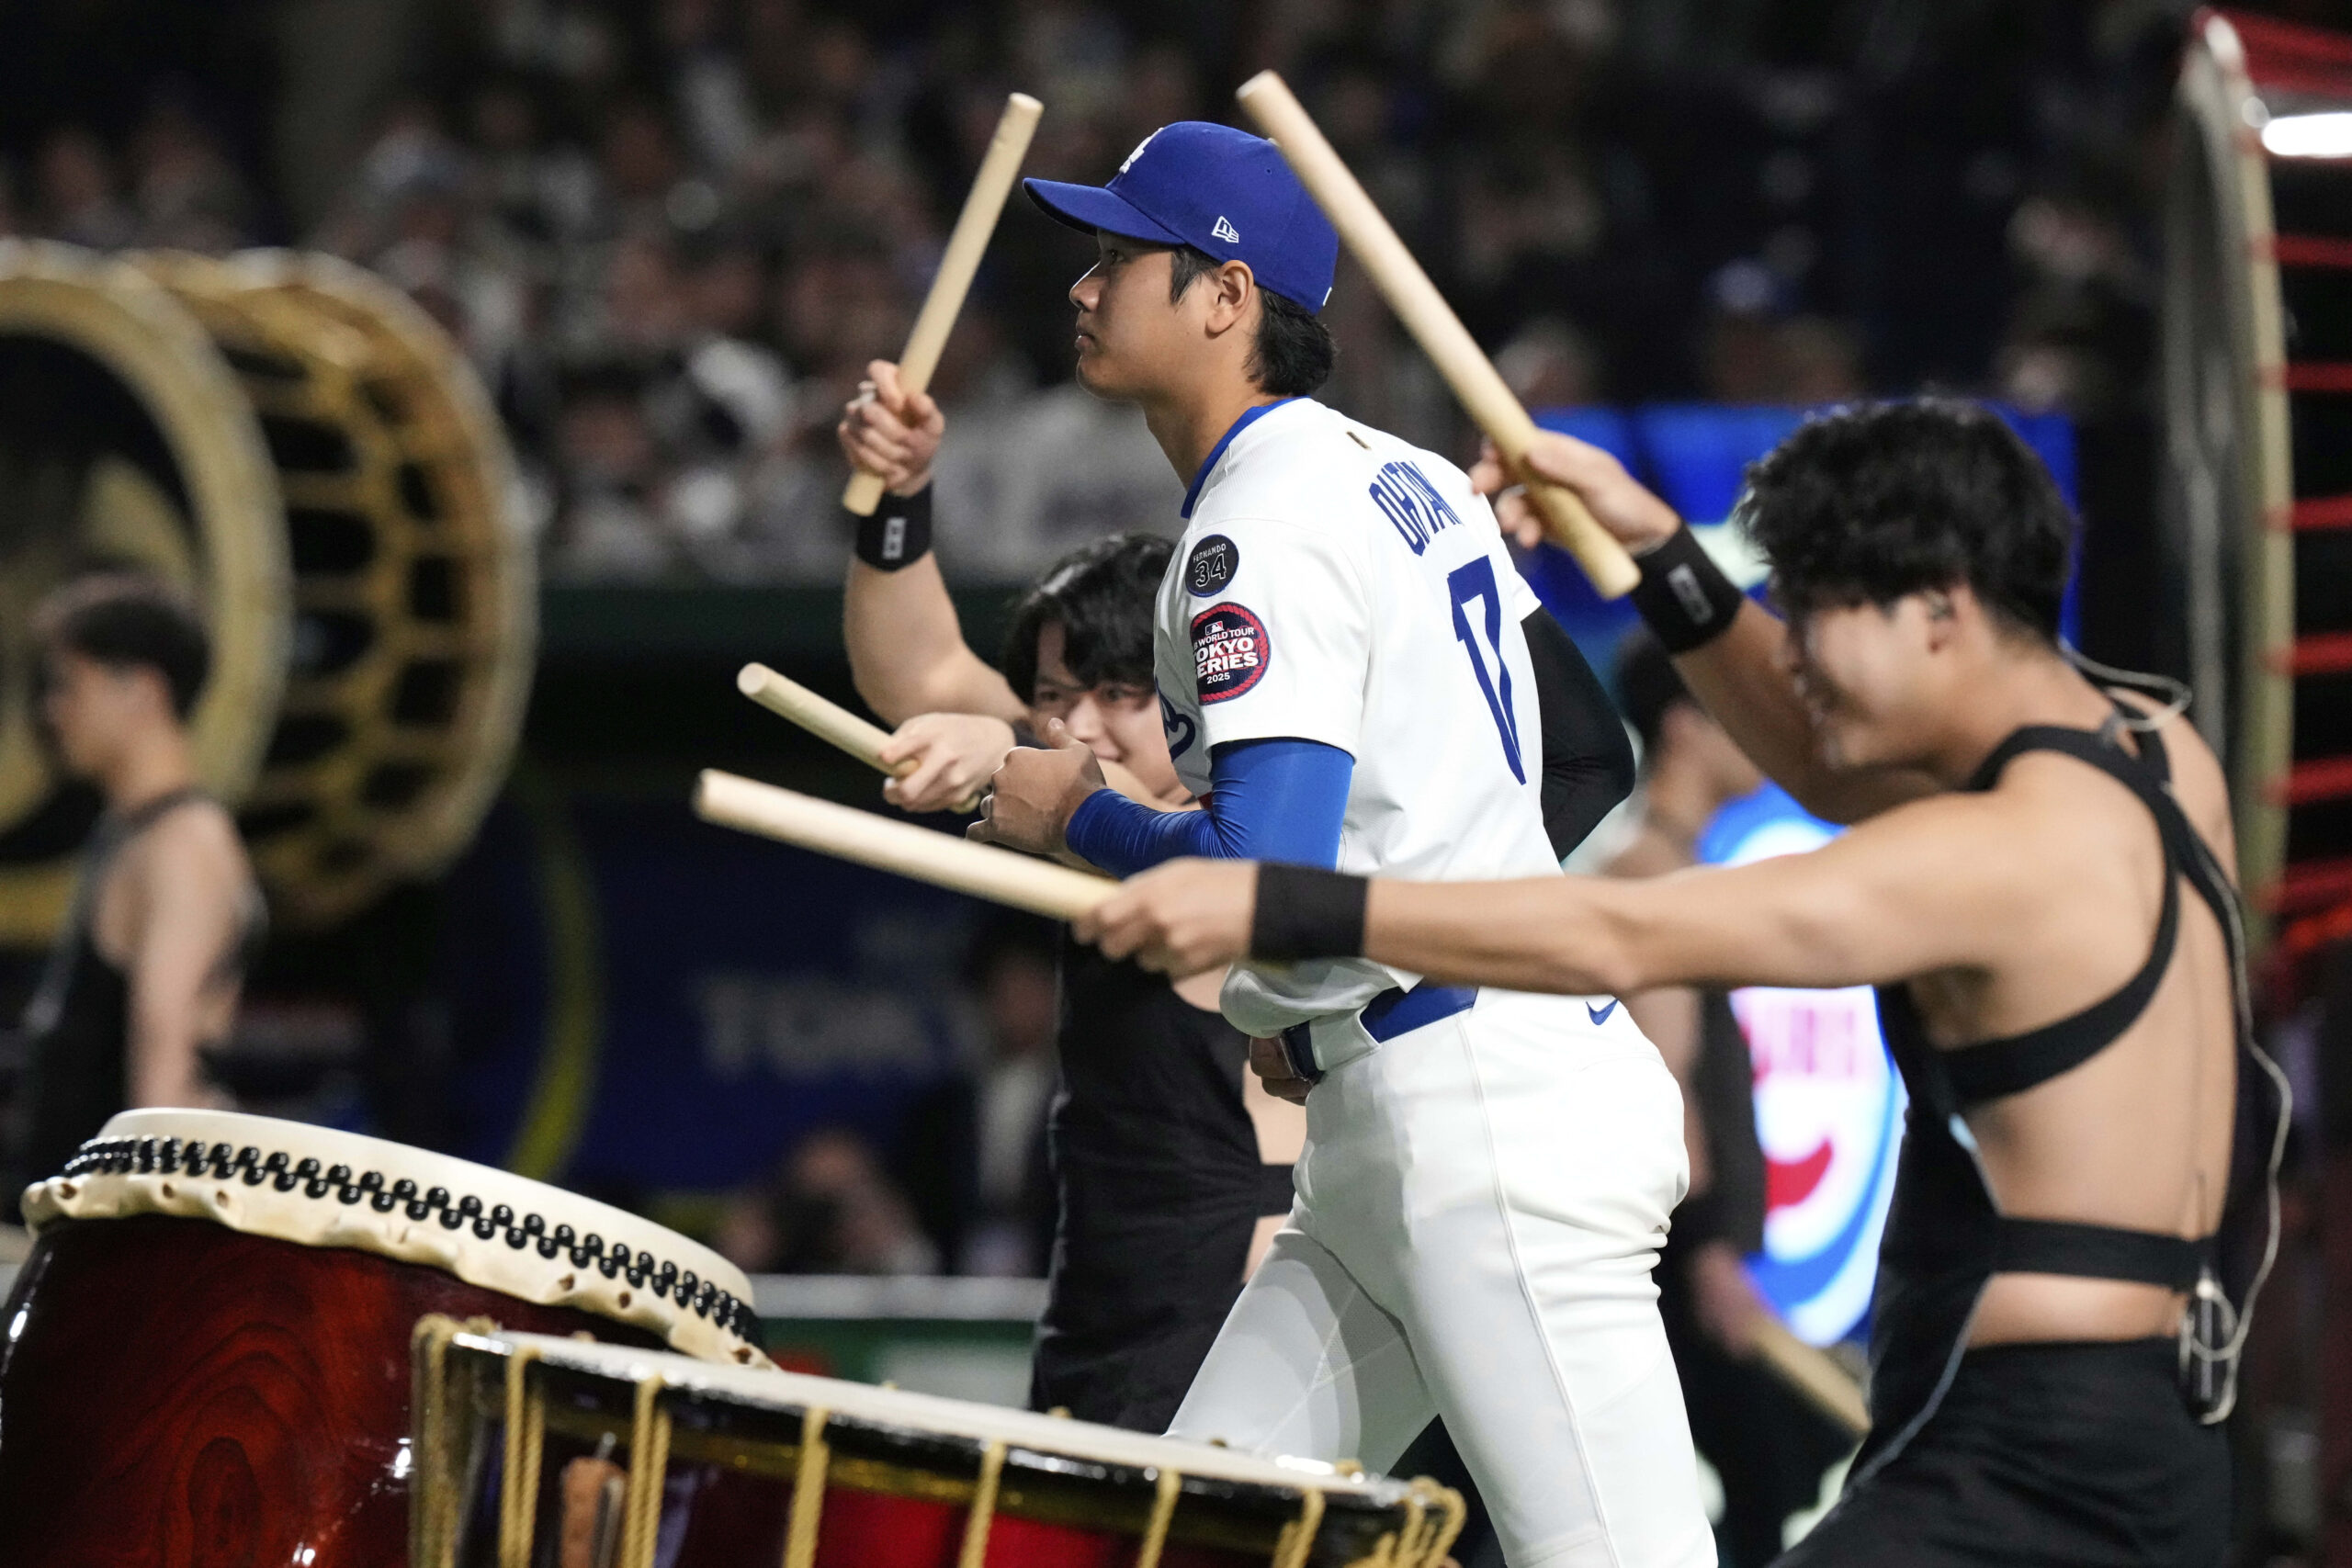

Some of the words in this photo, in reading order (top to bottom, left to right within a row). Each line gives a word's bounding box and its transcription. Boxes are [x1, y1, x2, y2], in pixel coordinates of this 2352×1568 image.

[1193, 543, 1227, 563] FERNANDO
[1194, 553, 1227, 587] 34
[1198, 631, 1228, 646] WORLD
[1229, 627, 1255, 637] TOUR
[1194, 637, 1254, 663] OKYO
[1196, 651, 1259, 679] ERIES
[1206, 672, 1230, 684] 2025
[1447, 554, 1526, 786] 17
